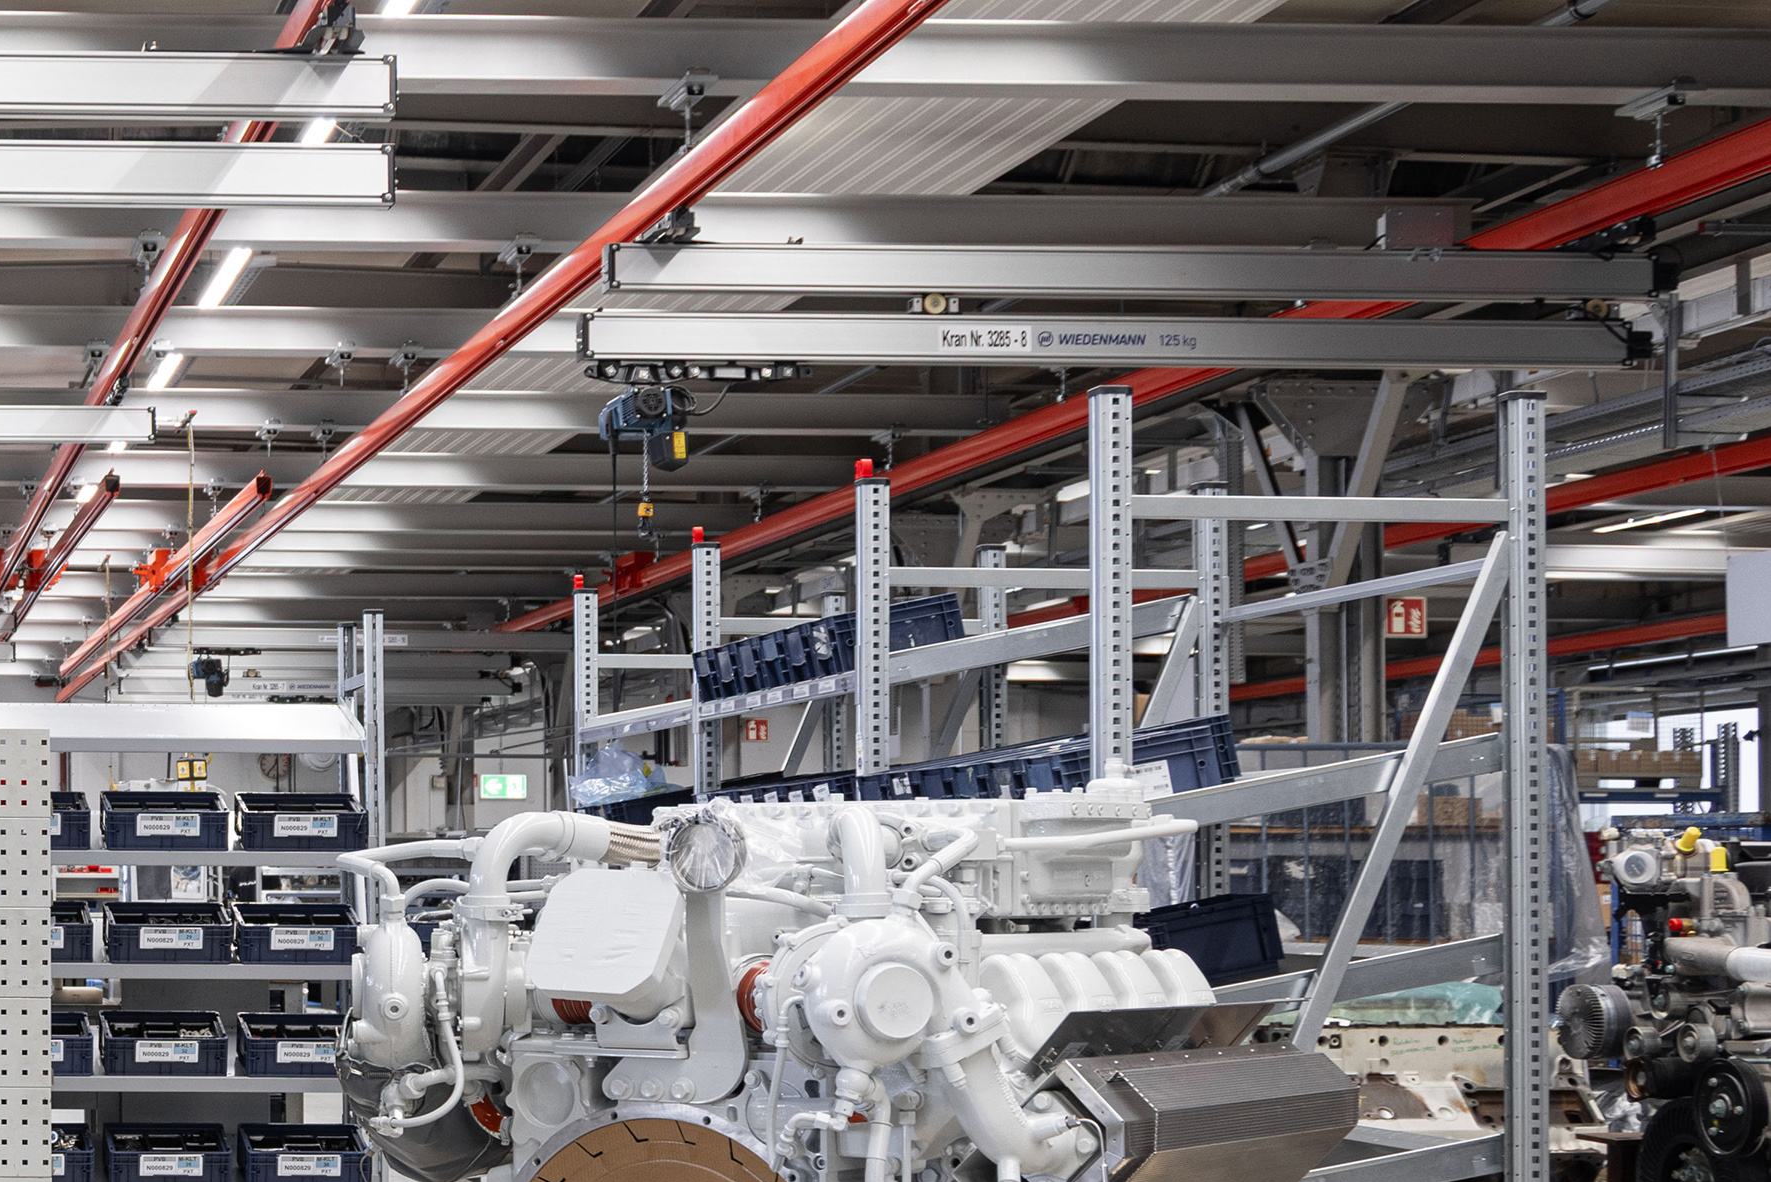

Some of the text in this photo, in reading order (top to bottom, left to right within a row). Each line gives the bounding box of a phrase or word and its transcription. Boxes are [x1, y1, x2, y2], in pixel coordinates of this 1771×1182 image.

[942, 330, 967, 347] Kran
[970, 330, 984, 347] Nr.
[987, 330, 1011, 347] 3285
[1021, 330, 1027, 347] 8
[1058, 334, 1146, 346] WIEDENMANN
[1160, 334, 1197, 349] 125 kg
